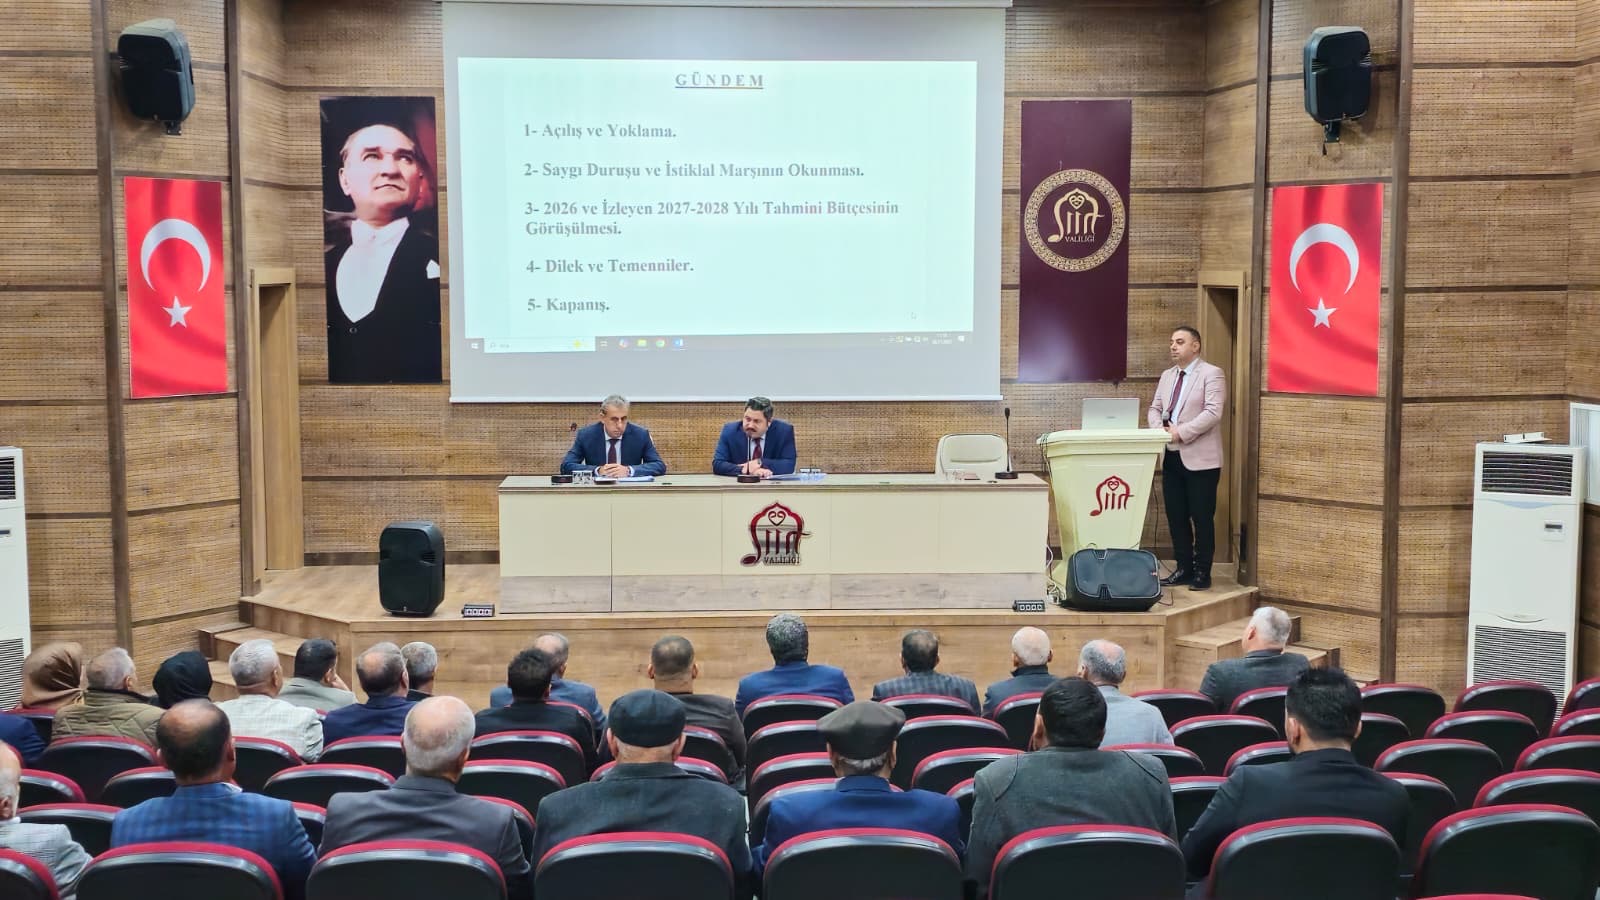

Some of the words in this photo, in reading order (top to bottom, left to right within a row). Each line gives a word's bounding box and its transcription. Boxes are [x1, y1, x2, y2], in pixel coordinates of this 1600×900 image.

[524, 123, 537, 137] 1-
[542, 123, 583, 140] Açılış
[586, 128, 603, 137] ve
[607, 123, 677, 138] Yoklama.
[523, 163, 539, 176] 2-
[542, 163, 583, 180] Saygı
[587, 163, 641, 180] Duruşu
[645, 167, 662, 177] ve
[665, 160, 715, 177] İstiklal
[719, 163, 784, 180] Marşının
[787, 163, 865, 177] Okunması.
[524, 202, 540, 216] 3-
[543, 202, 578, 215] 2026
[582, 206, 599, 216] ve
[601, 199, 653, 219] İzleyen
[657, 201, 729, 215] 2027-2028
[733, 201, 759, 215] Yılı
[763, 201, 822, 215] Tahmini
[827, 201, 899, 217] Bütçesinin
[525, 221, 622, 238] Görüşülmesi.
[526, 260, 541, 273] 4-
[545, 259, 584, 273] Dilek
[588, 263, 604, 273] ve
[608, 258, 695, 273] Temenniler.
[527, 298, 542, 312] 5-
[546, 298, 611, 315] Kapanış.
